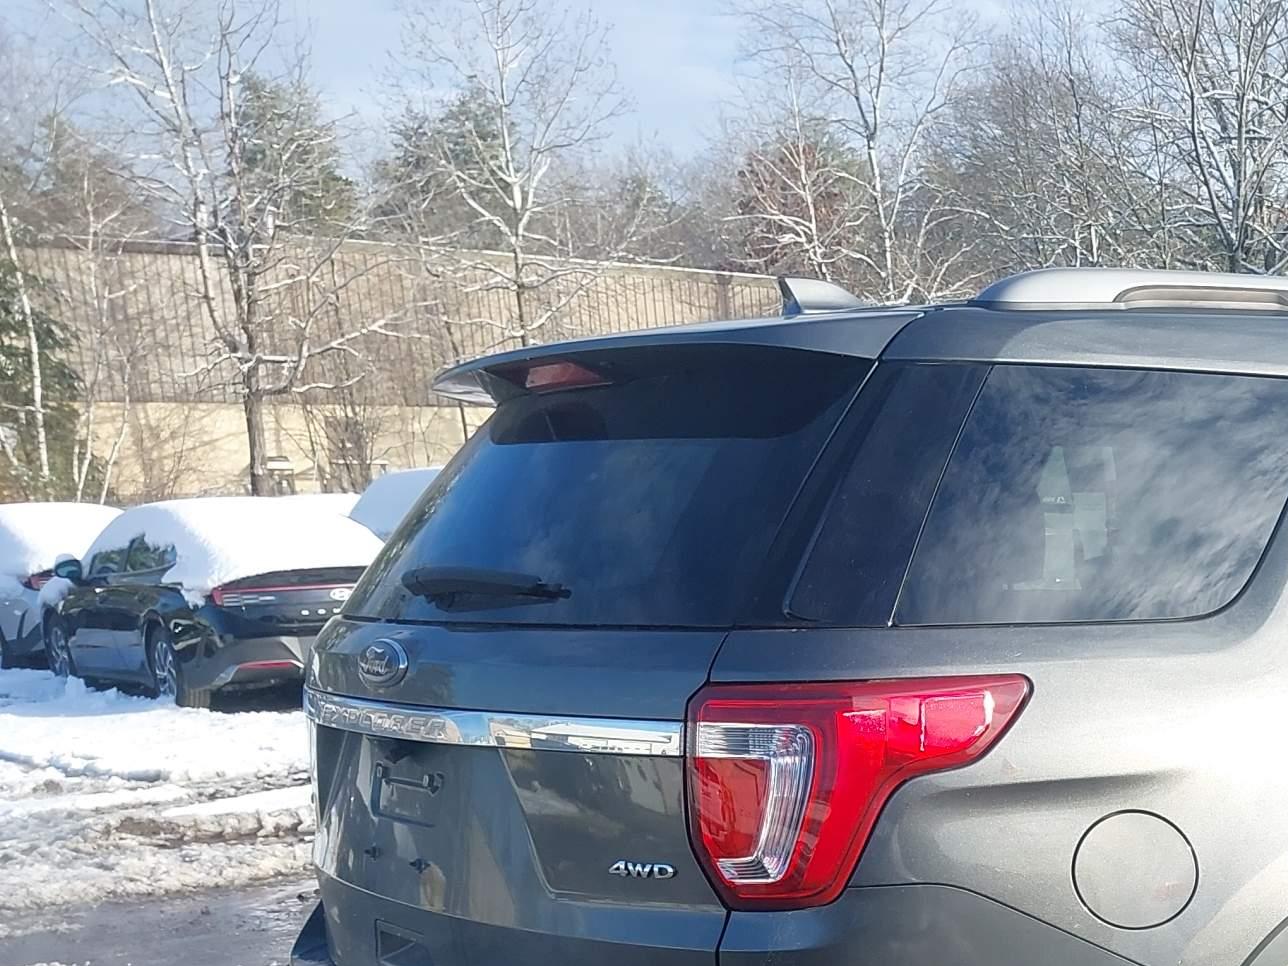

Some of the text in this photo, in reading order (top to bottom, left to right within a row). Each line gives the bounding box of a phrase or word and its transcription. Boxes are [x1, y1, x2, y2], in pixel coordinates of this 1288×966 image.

[360, 646, 390, 674] Ford
[320, 702, 447, 739] EXPLORER
[608, 860, 675, 879] 4WD
